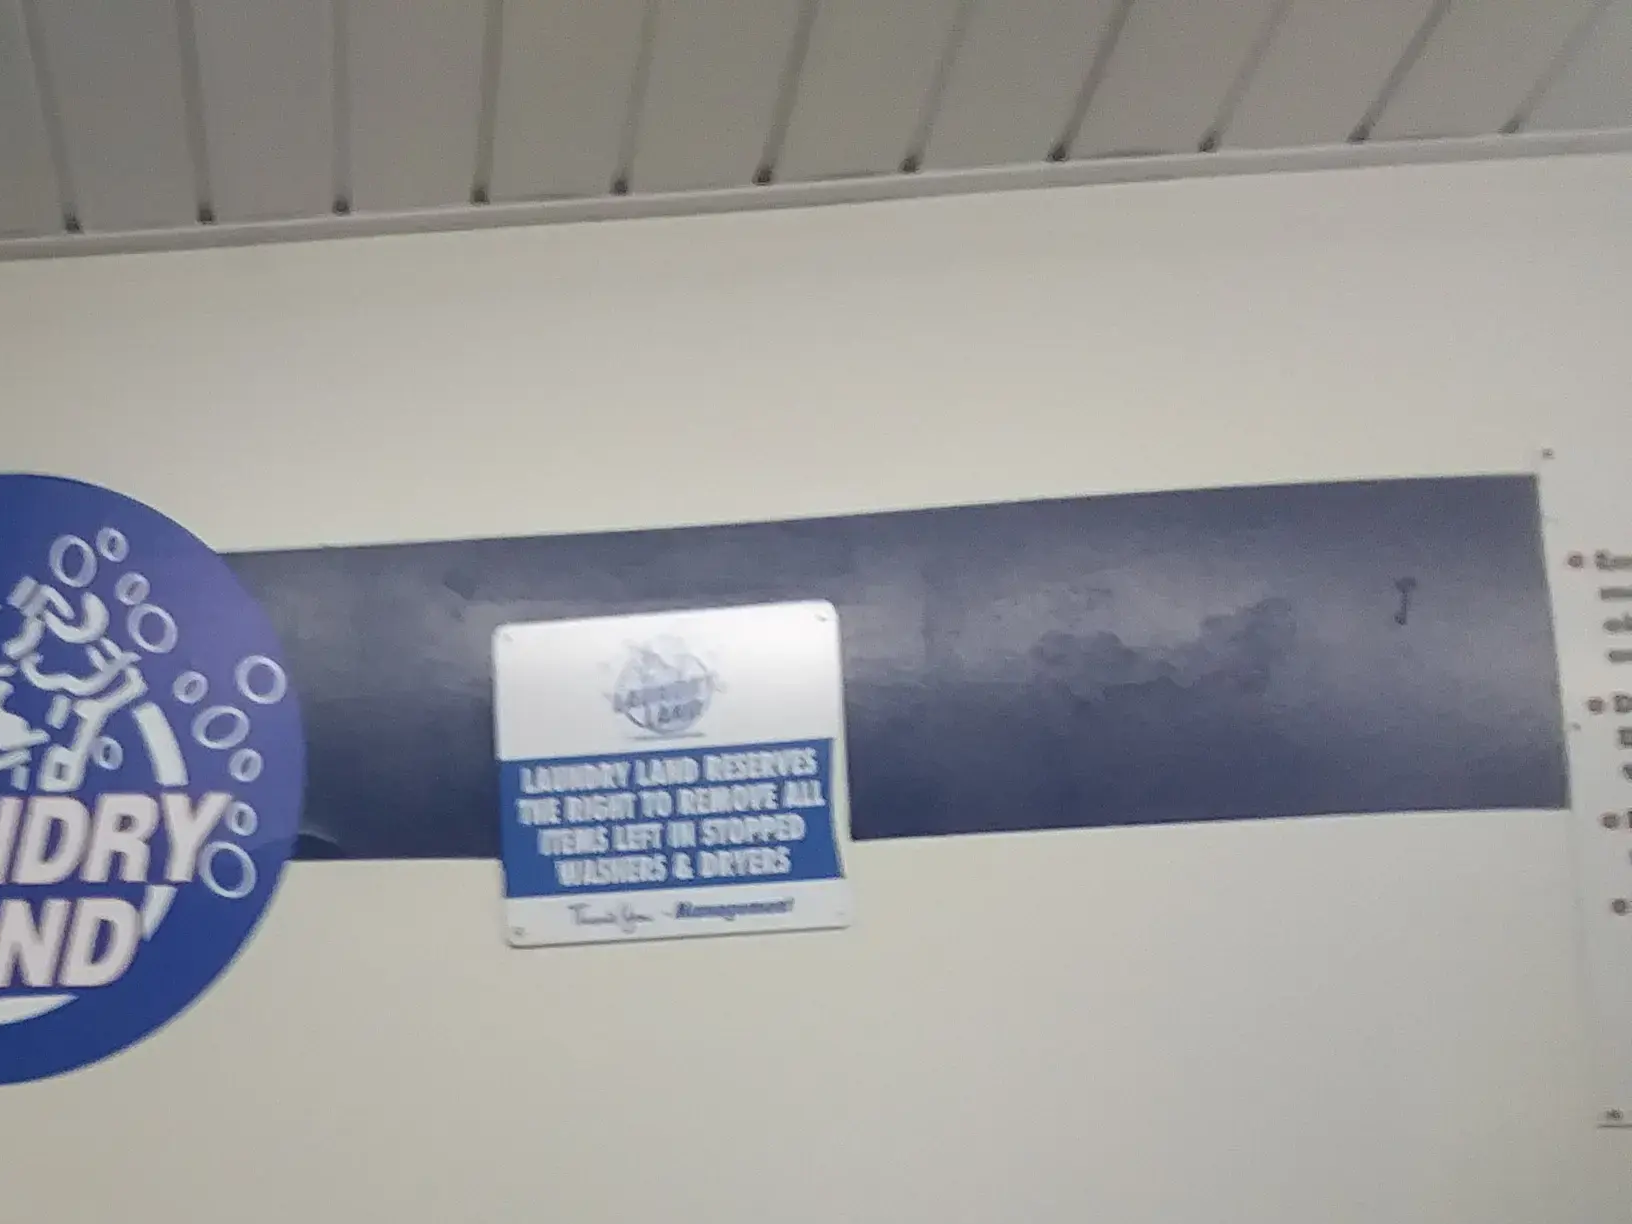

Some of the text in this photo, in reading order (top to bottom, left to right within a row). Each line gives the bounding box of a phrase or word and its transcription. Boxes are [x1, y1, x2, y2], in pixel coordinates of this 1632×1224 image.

[521, 749, 818, 794] LAUNDRY LAND RESERVES
[640, 792, 672, 818] TO
[678, 785, 779, 815] REMOVE
[614, 824, 663, 851] LEFT
[669, 822, 696, 848] IN
[702, 815, 806, 846] STOPPED
[556, 855, 668, 887] WASHERS
[699, 848, 792, 878] DRYERS
